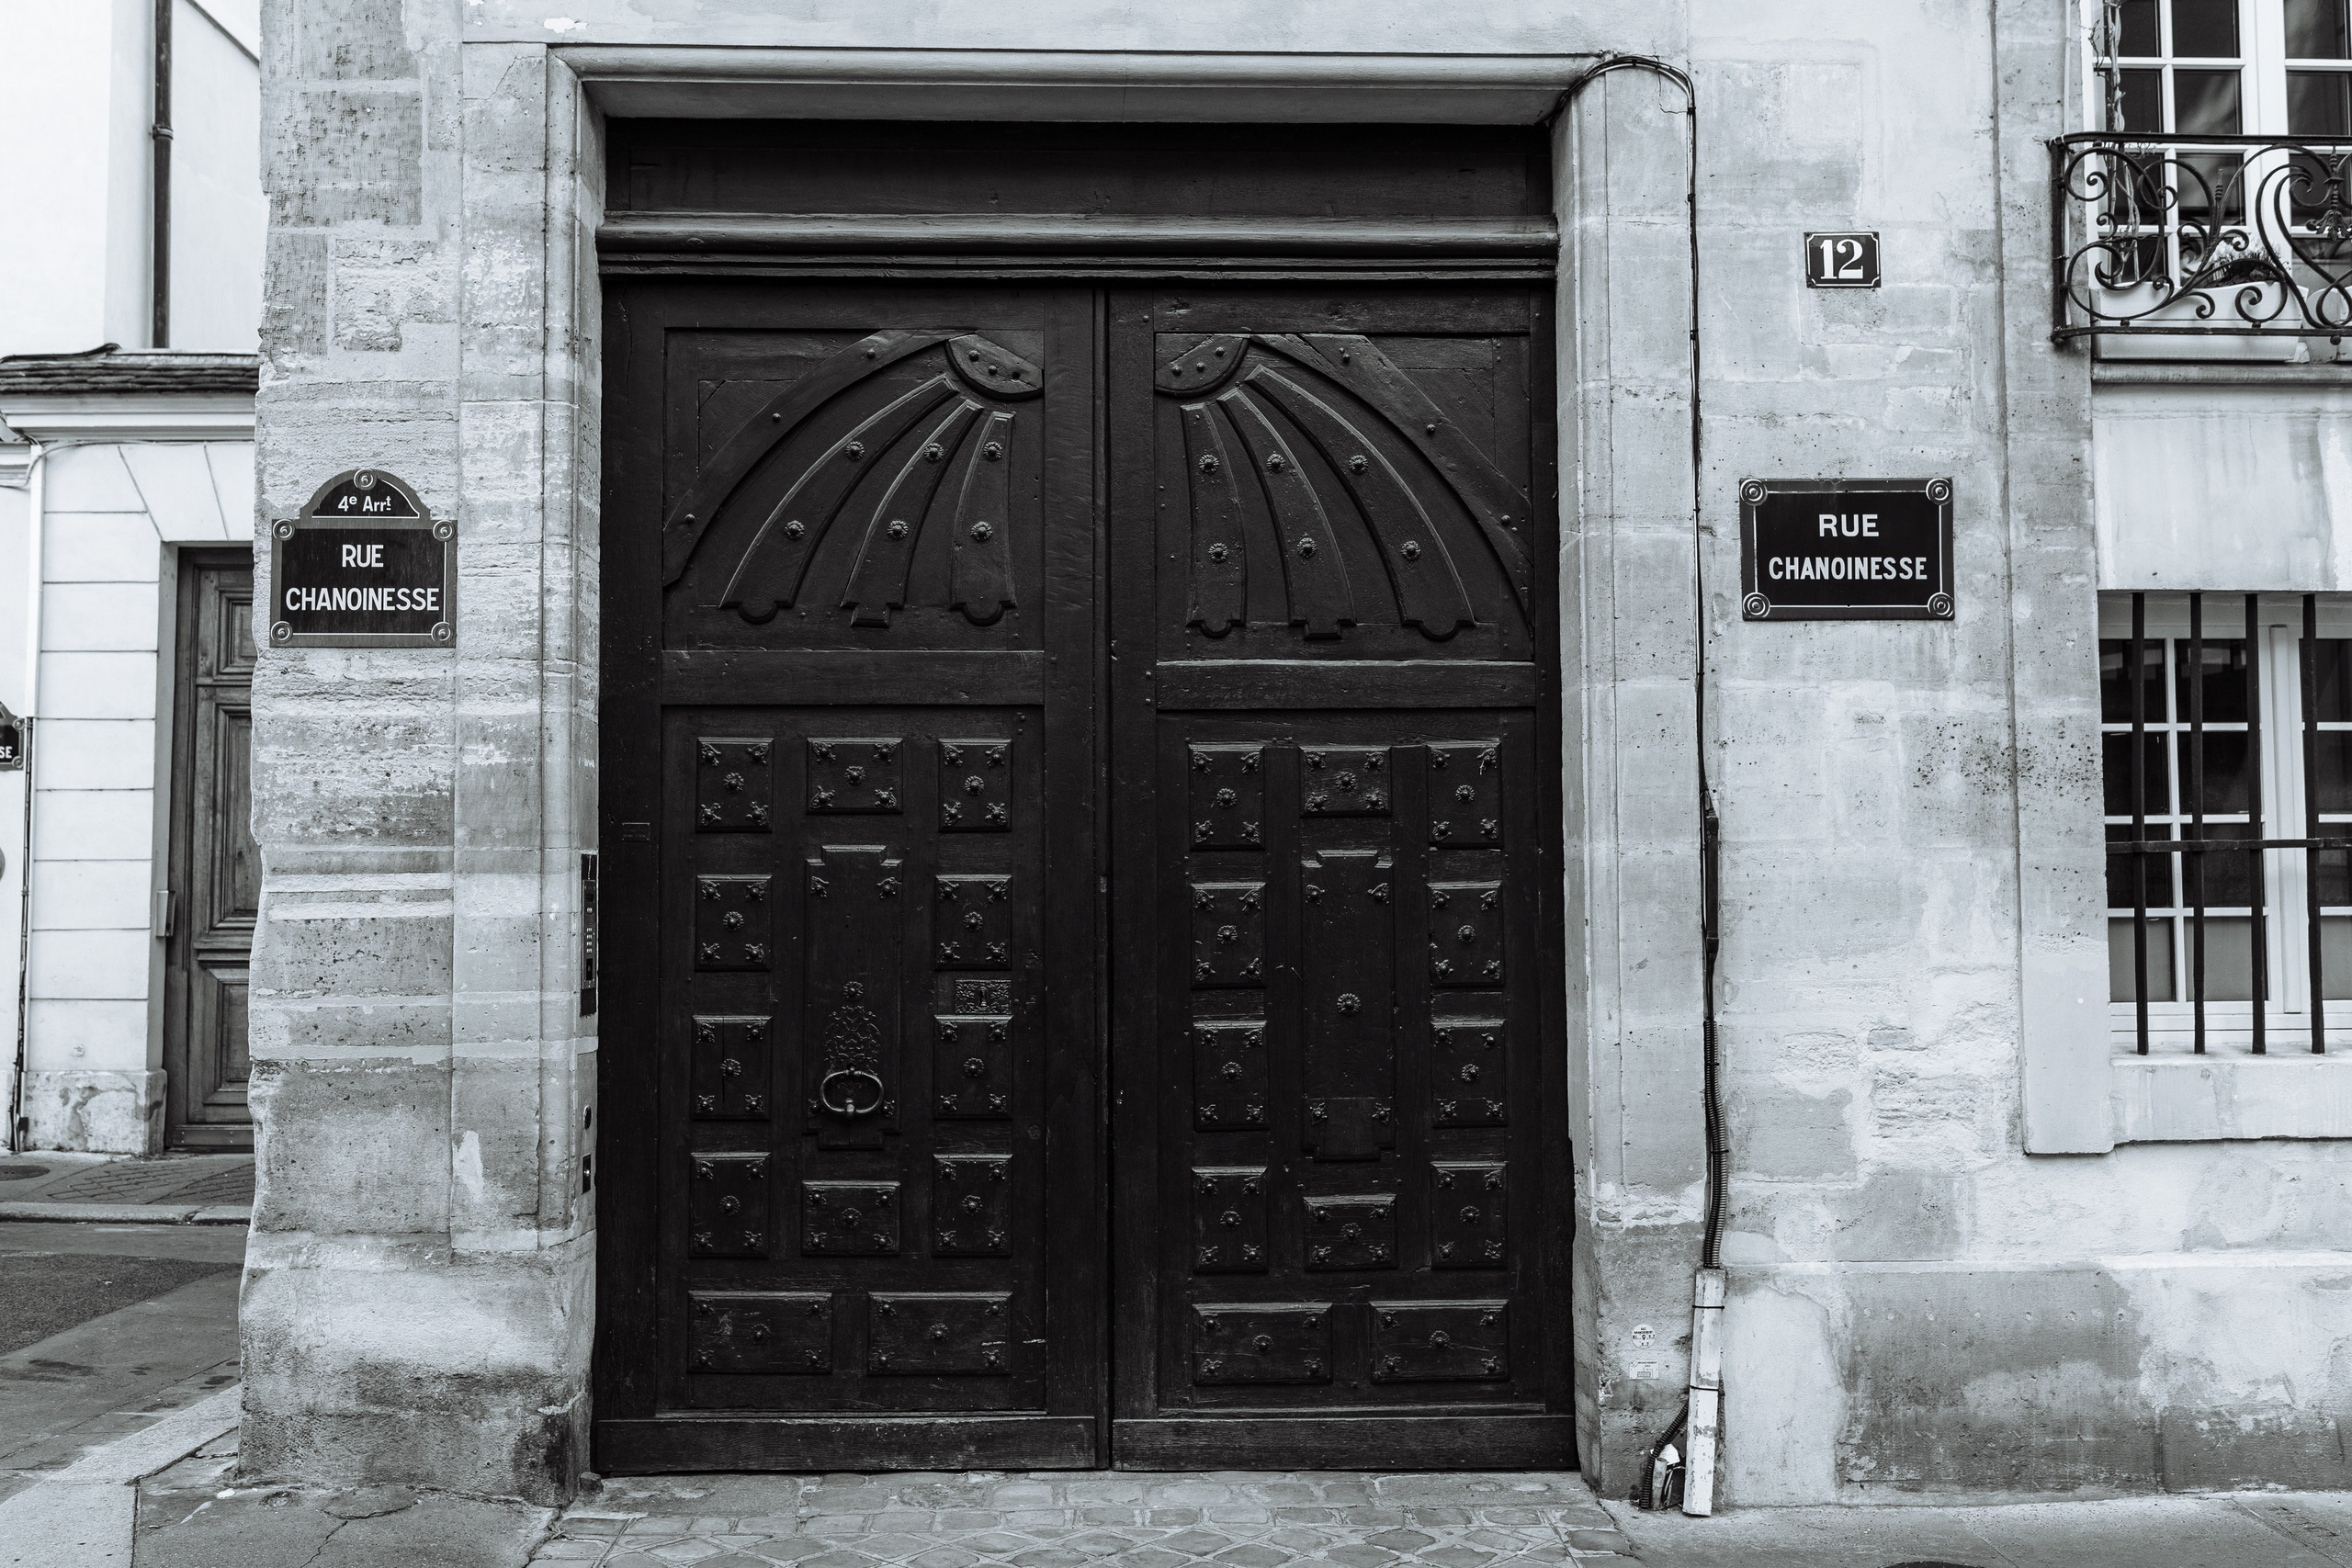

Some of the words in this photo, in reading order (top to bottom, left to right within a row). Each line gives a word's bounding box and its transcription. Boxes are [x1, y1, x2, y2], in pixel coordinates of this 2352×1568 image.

[1820, 239, 1863, 279] 12
[1819, 514, 1880, 536] RUE
[342, 545, 384, 567] RUE
[1769, 557, 1928, 580] CHANOINESSE
[286, 588, 439, 611] CHANOINESSE
